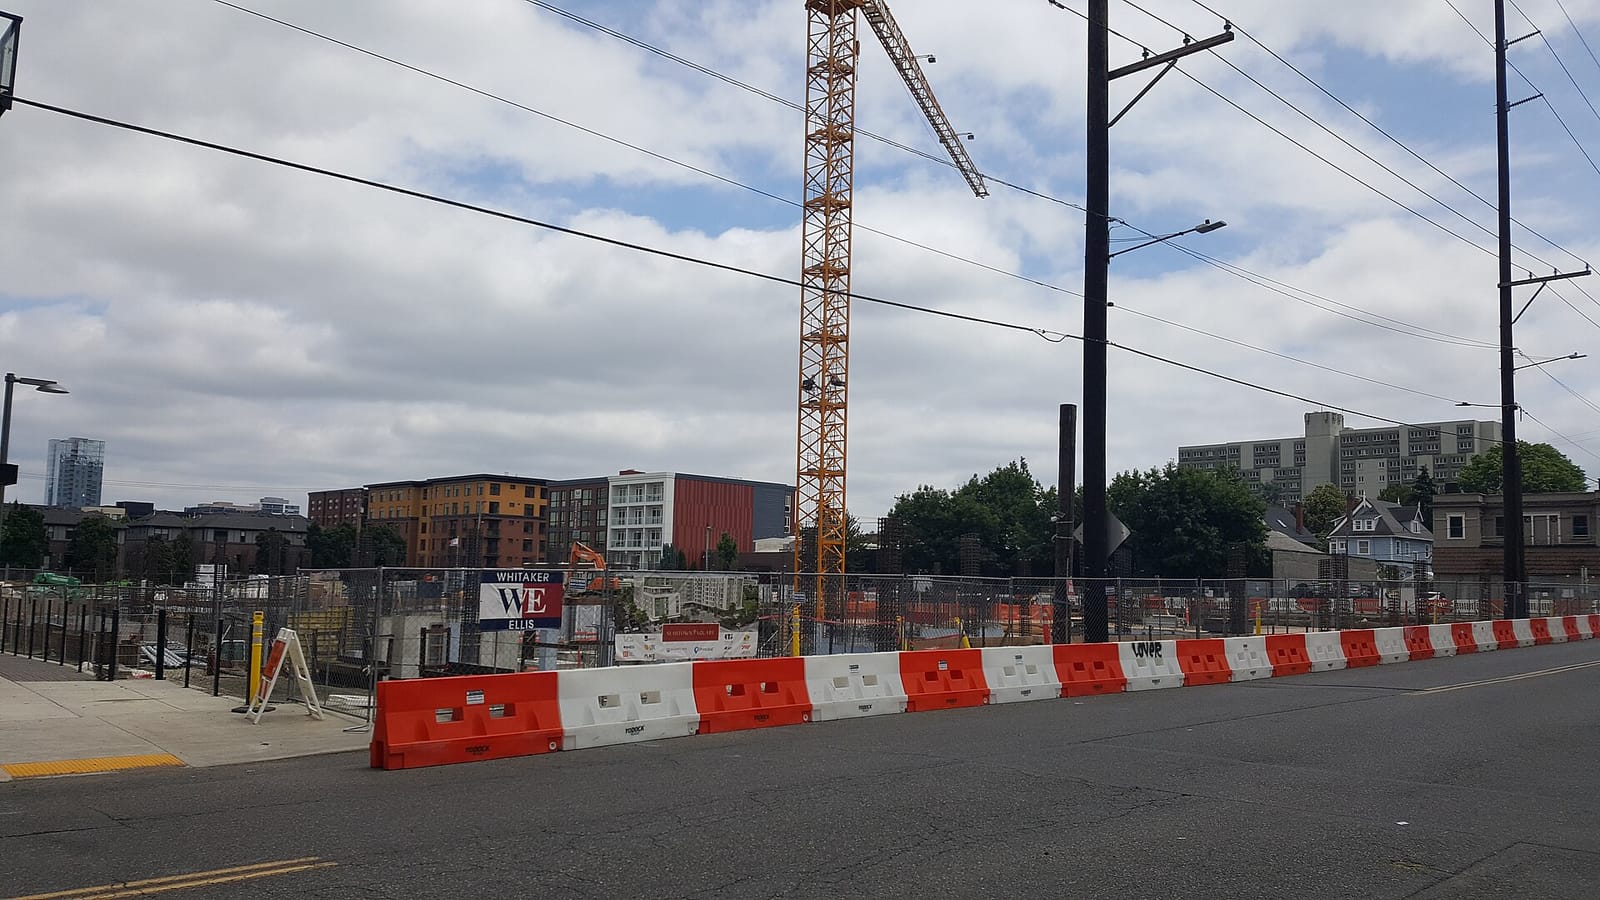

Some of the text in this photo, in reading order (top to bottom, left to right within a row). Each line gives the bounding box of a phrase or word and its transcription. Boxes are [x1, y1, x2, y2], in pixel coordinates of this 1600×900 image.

[496, 572, 550, 582] WHITAKER
[497, 587, 547, 614] WE
[508, 619, 535, 630] ELLIS
